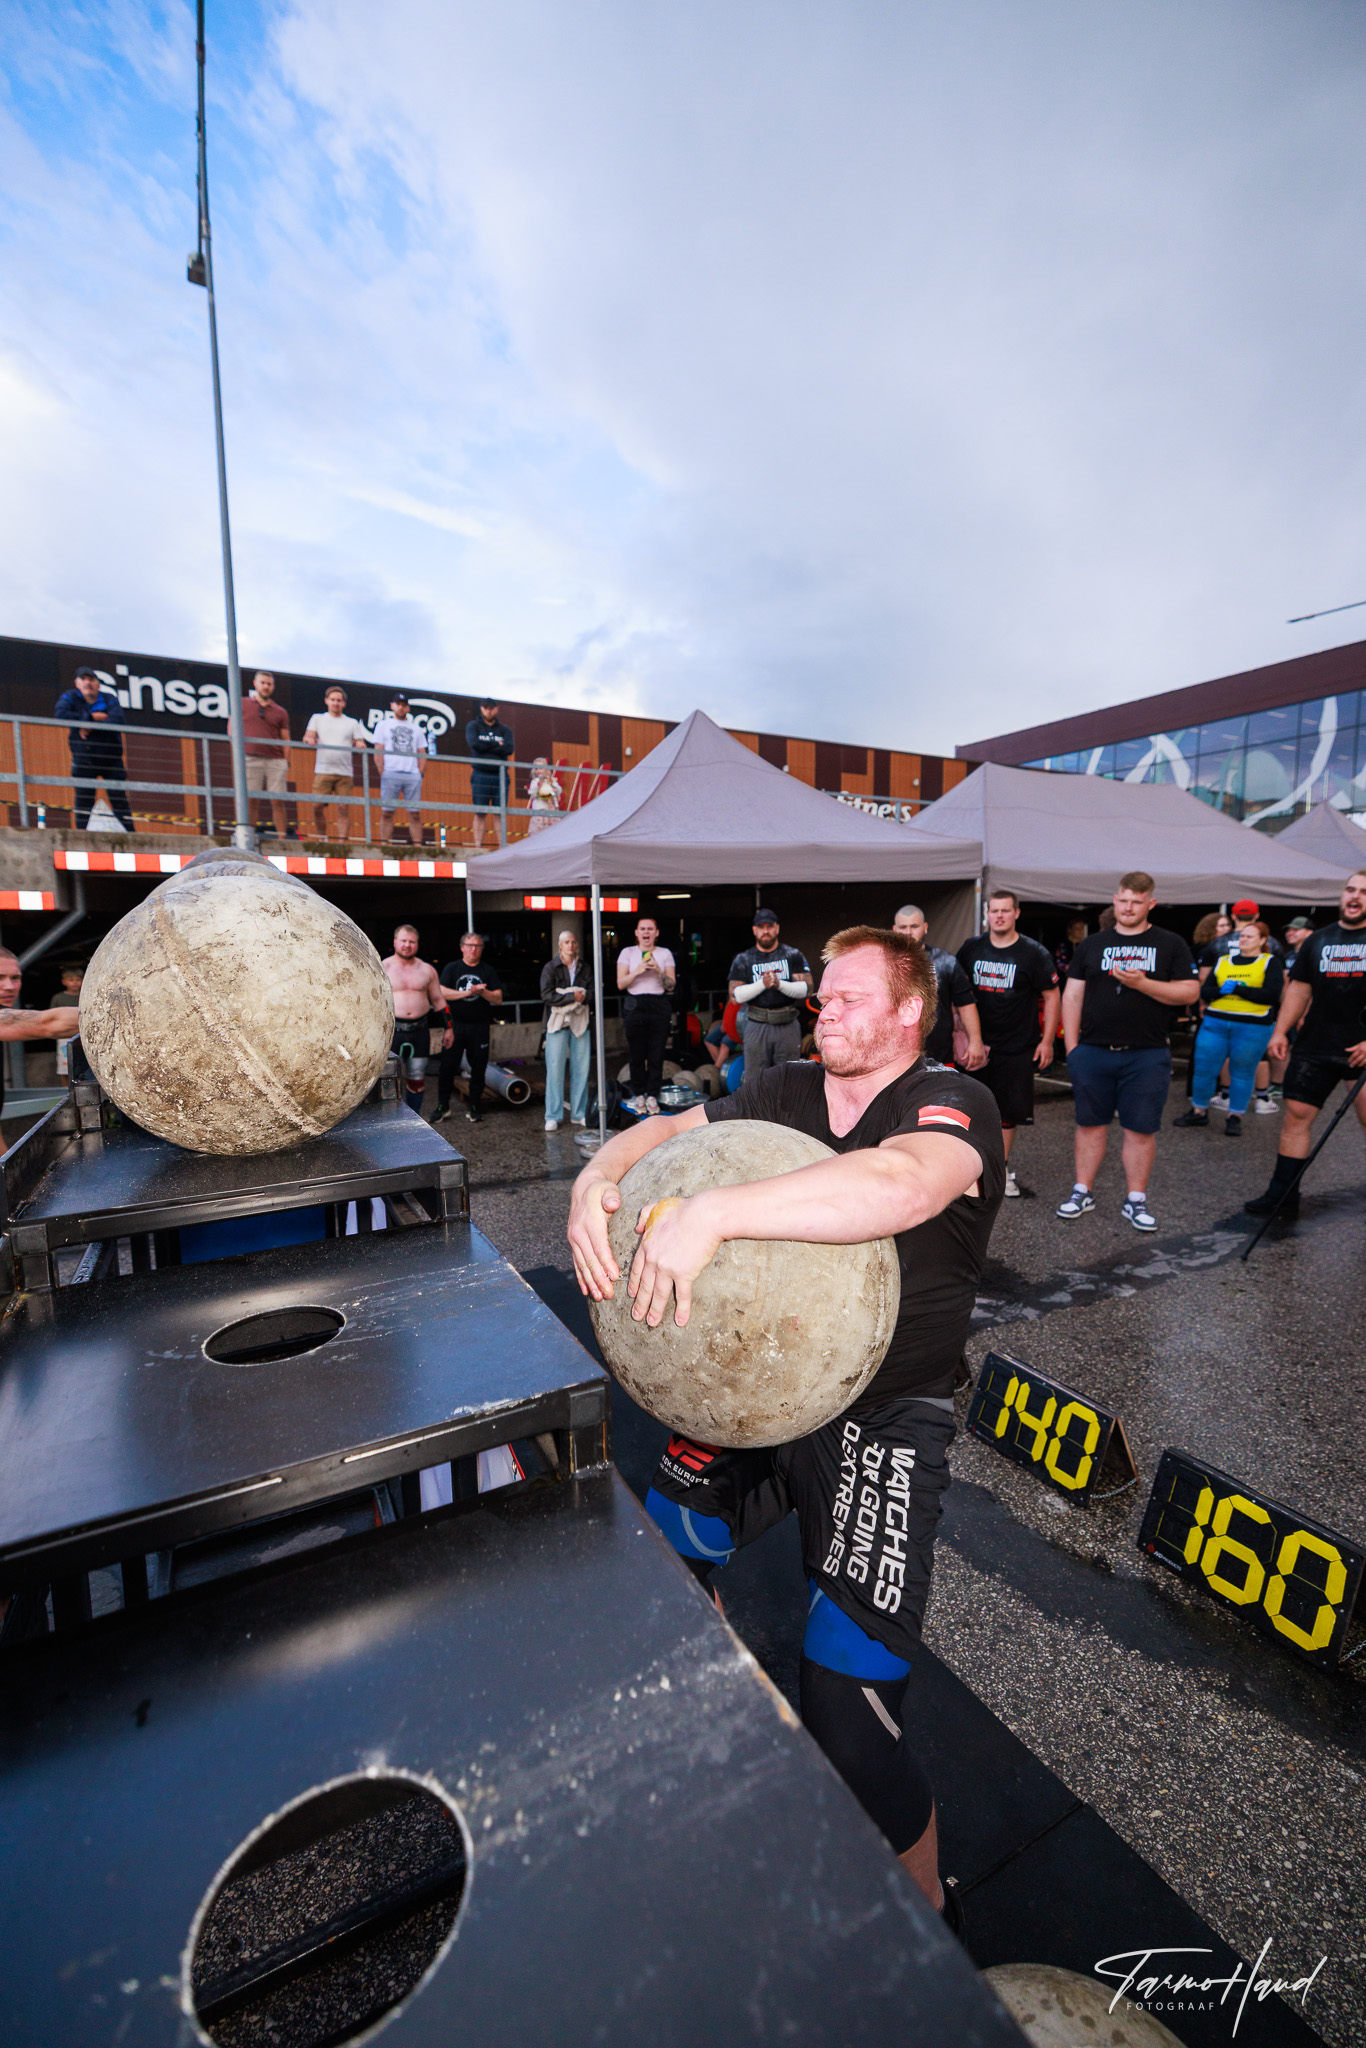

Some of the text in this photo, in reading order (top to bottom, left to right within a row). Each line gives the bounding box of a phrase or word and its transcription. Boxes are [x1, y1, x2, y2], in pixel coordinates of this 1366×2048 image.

[93, 664, 240, 719] sinsa
[368, 708, 448, 736] PCO
[672, 1464, 711, 1486] EUROPE
[995, 1376, 1101, 1491] 140
[846, 1485, 881, 1584] GOING
[873, 1447, 916, 1614] WATCHES
[1183, 1486, 1348, 1652] 160
